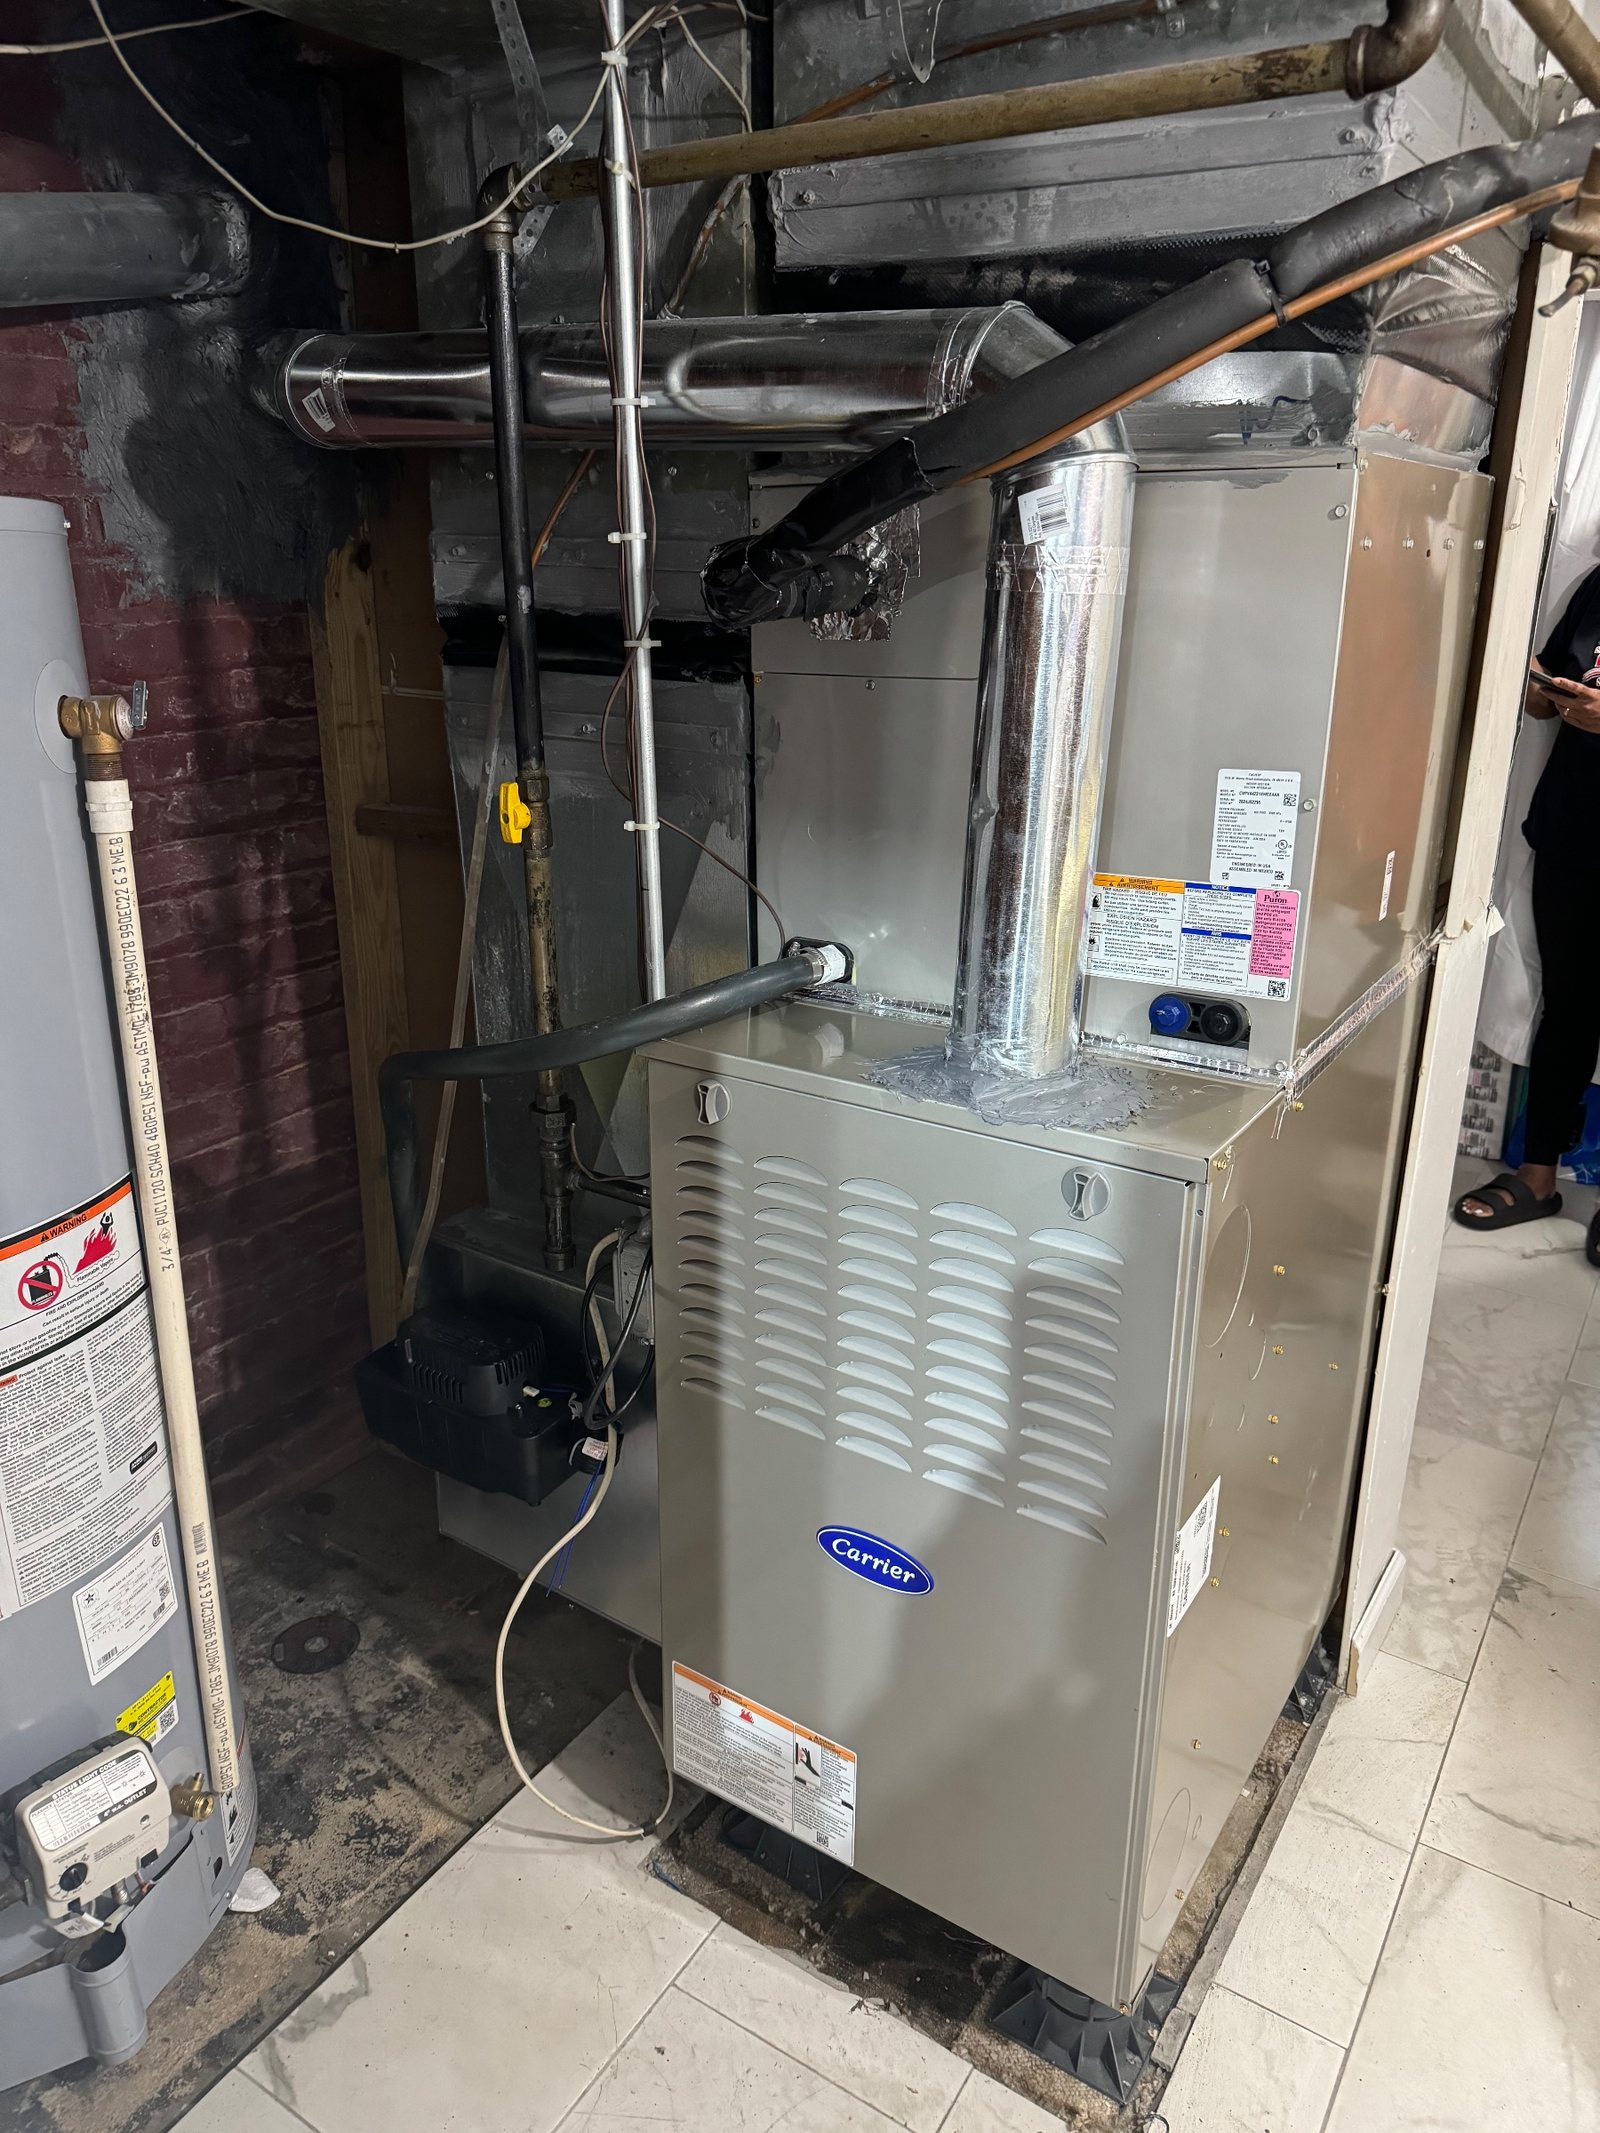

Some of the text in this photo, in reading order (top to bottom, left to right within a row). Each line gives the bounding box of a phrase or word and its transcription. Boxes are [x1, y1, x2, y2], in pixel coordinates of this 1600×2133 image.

[112, 866, 126, 876] 3
[114, 877, 127, 886] 6
[1264, 894, 1287, 903] Puron
[139, 1058, 154, 1100] NSF-pw
[142, 1102, 159, 1142] 480PSI
[147, 1142, 164, 1179] SCH40
[152, 1180, 170, 1226] PVC1120
[49, 1212, 86, 1238] WARNING
[57, 1303, 66, 1311] AND
[18, 1367, 35, 1379] Protect
[37, 1359, 53, 1371] against
[197, 1560, 208, 1568] B
[832, 1538, 916, 1583] Carrier
[197, 1568, 211, 1583] ME
[198, 1583, 211, 1591] 3
[200, 1590, 212, 1599] 6
[206, 1640, 220, 1674] JM9078
[208, 1675, 224, 1730] ASTMD-1785
[52, 1760, 118, 1800] STATUS LIGHT CODE
[102, 1808, 112, 1817] 4"
[123, 1787, 147, 1808] OUTLET
